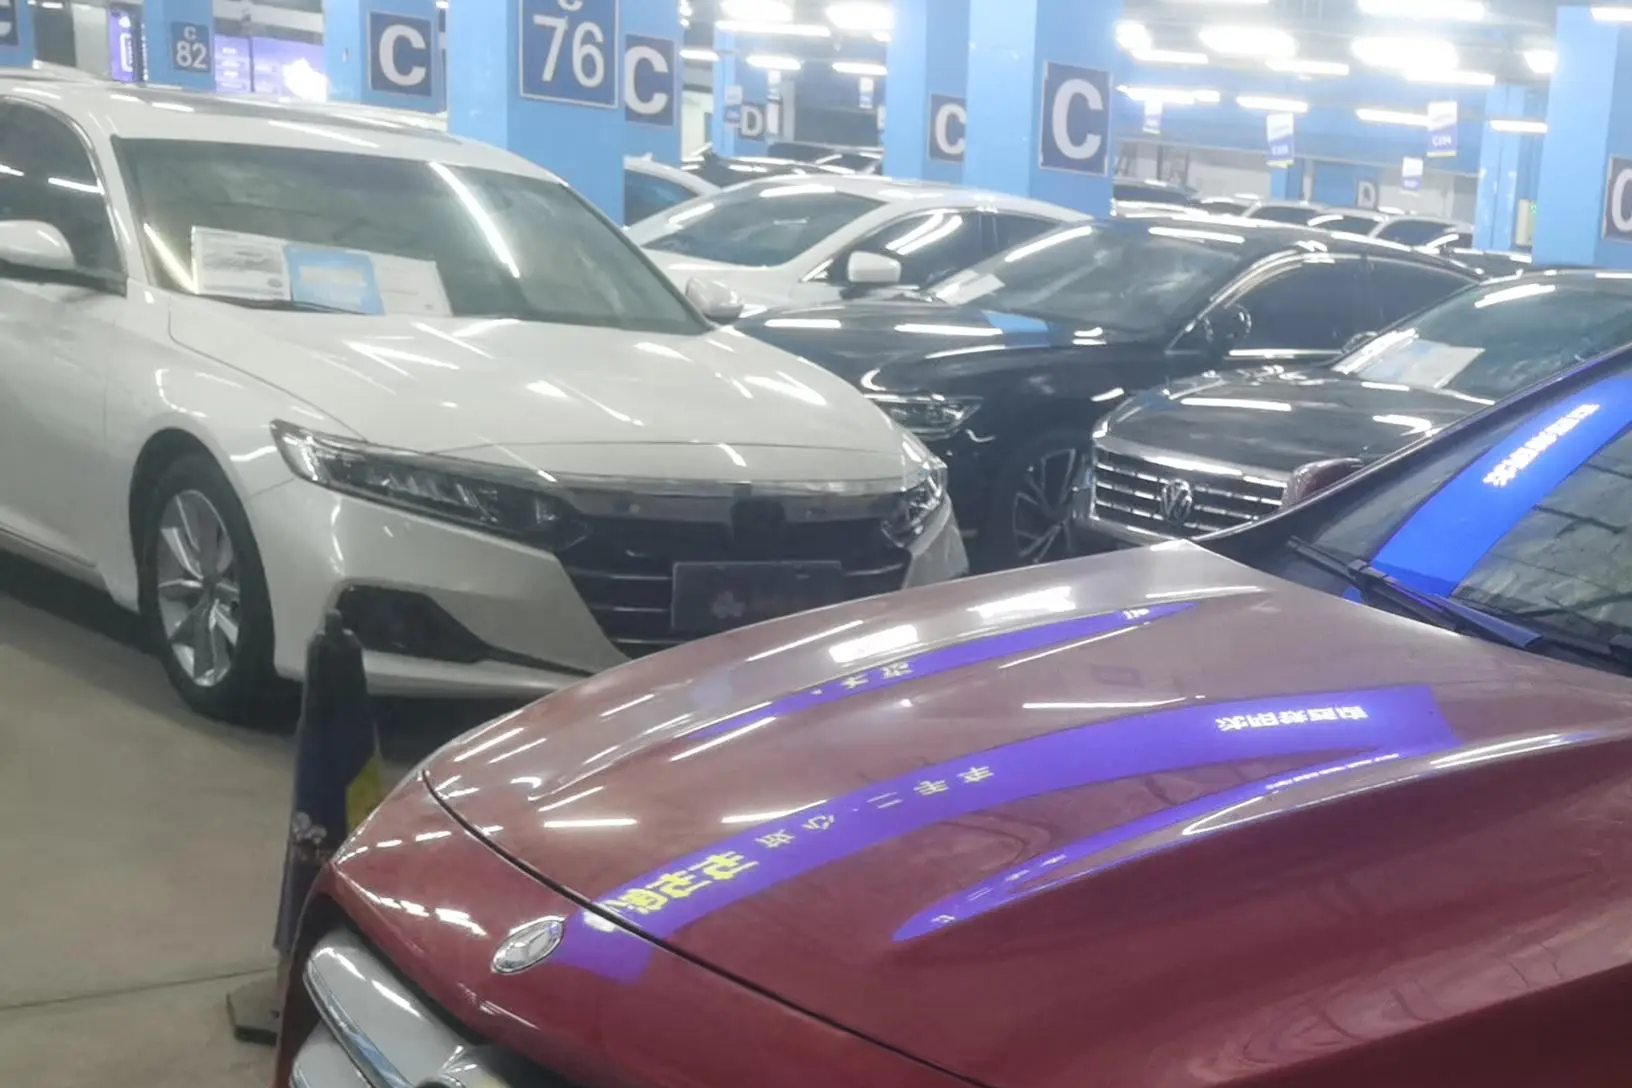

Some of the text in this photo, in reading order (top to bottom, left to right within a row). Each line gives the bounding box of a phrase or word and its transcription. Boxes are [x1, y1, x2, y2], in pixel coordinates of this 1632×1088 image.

[176, 40, 208, 69] 82
[184, 26, 197, 41] C
[378, 24, 427, 86] C
[532, 14, 605, 88] 76
[624, 45, 670, 115] C
[740, 104, 765, 137] D
[935, 103, 968, 155] C
[1052, 78, 1104, 160] C
